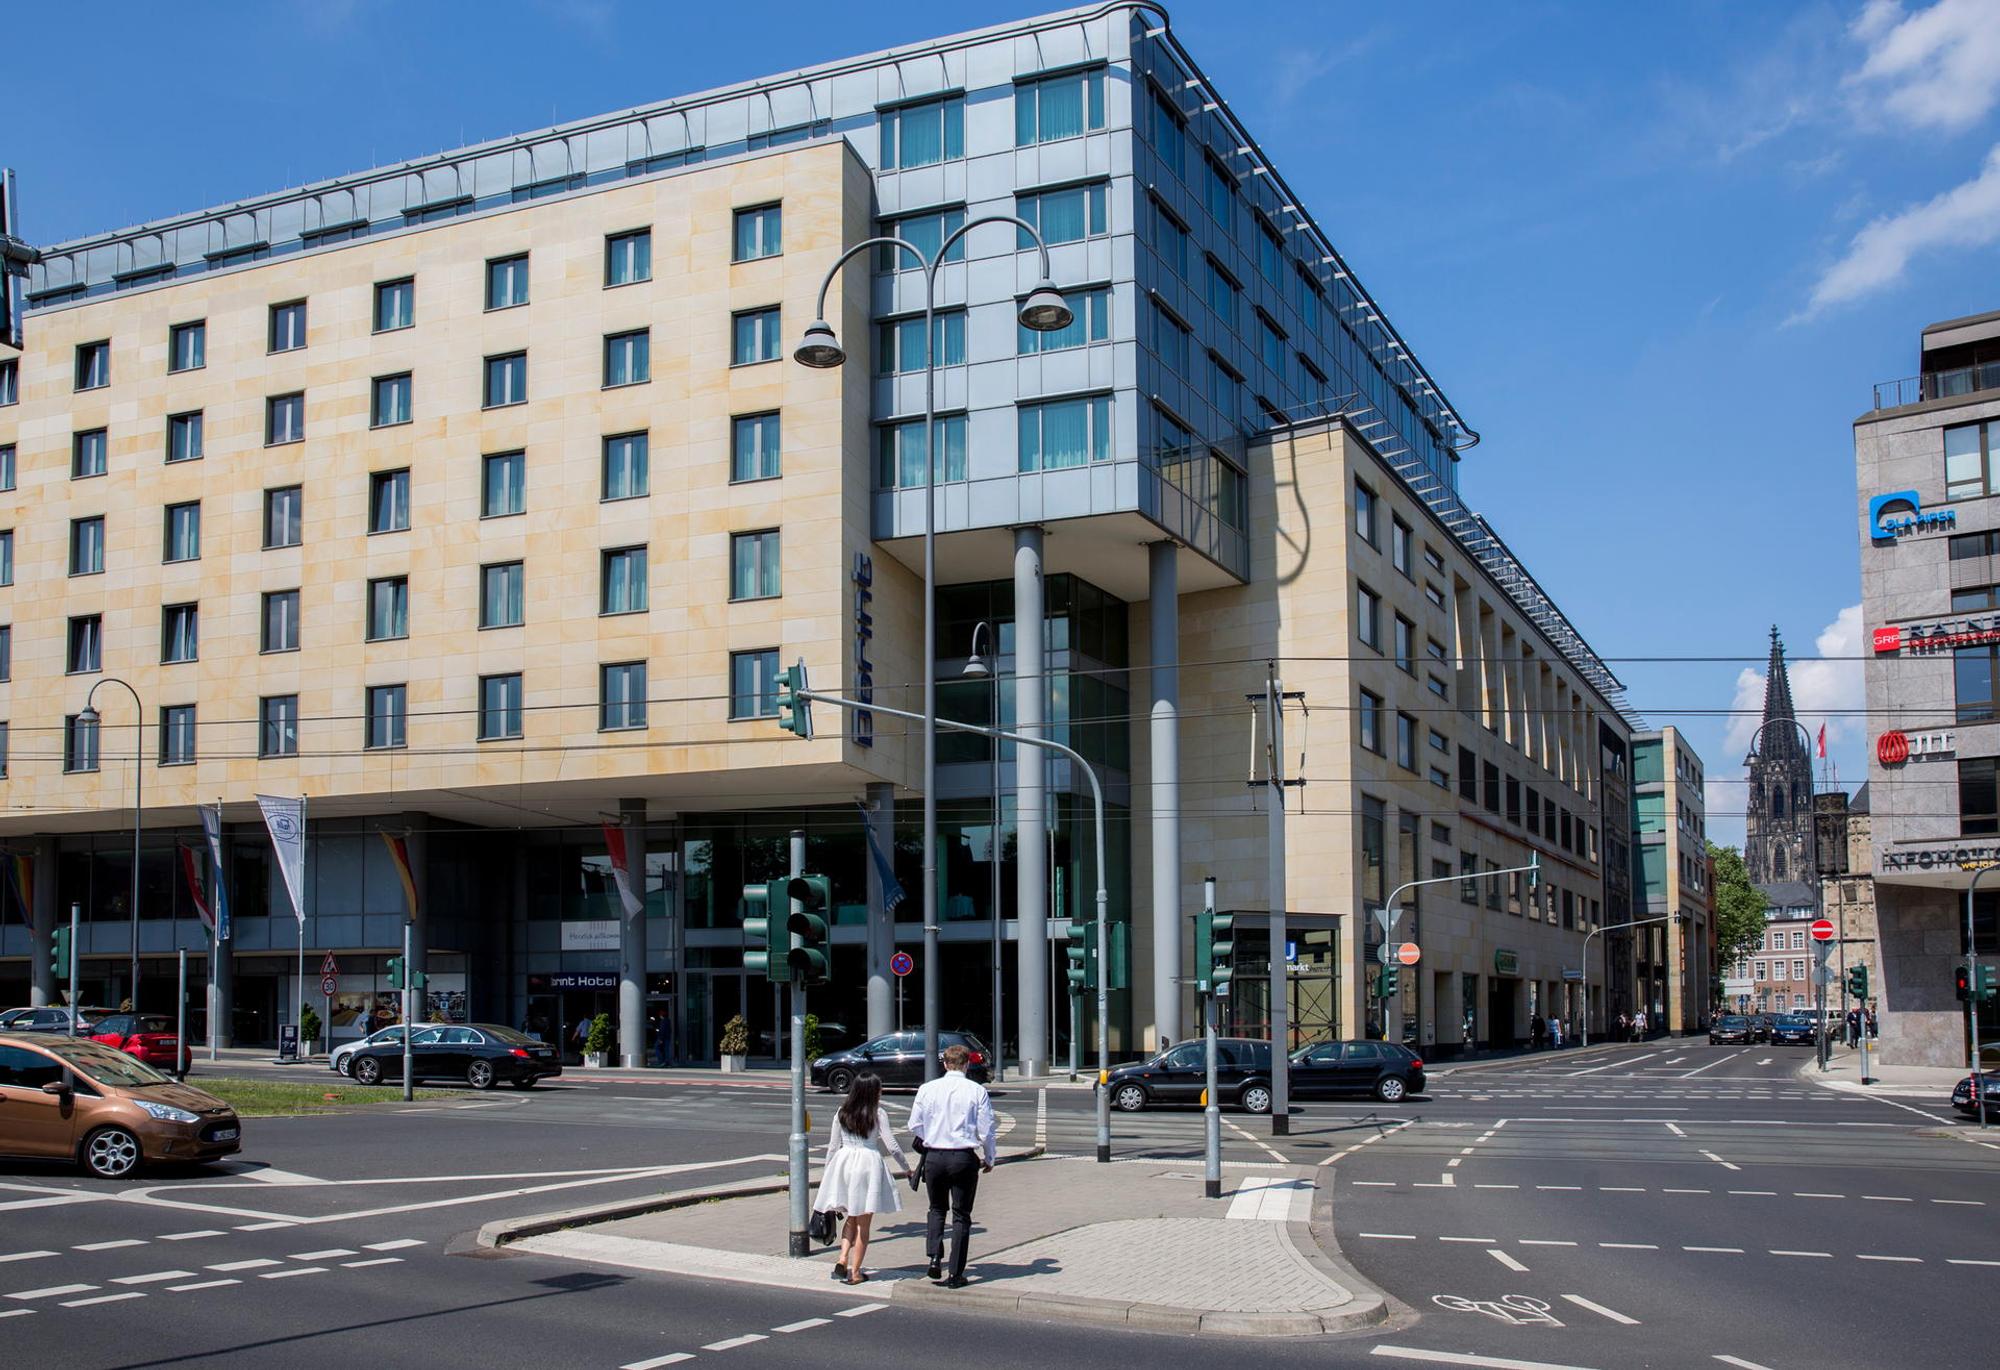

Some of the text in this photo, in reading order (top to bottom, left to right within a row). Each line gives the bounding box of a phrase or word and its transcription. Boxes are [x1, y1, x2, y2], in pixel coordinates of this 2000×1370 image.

[1916, 510, 1956, 524] PIPER
[1872, 634, 1900, 646] GRP
[1908, 732, 1955, 755] JLL
[578, 976, 616, 986] Hotel
